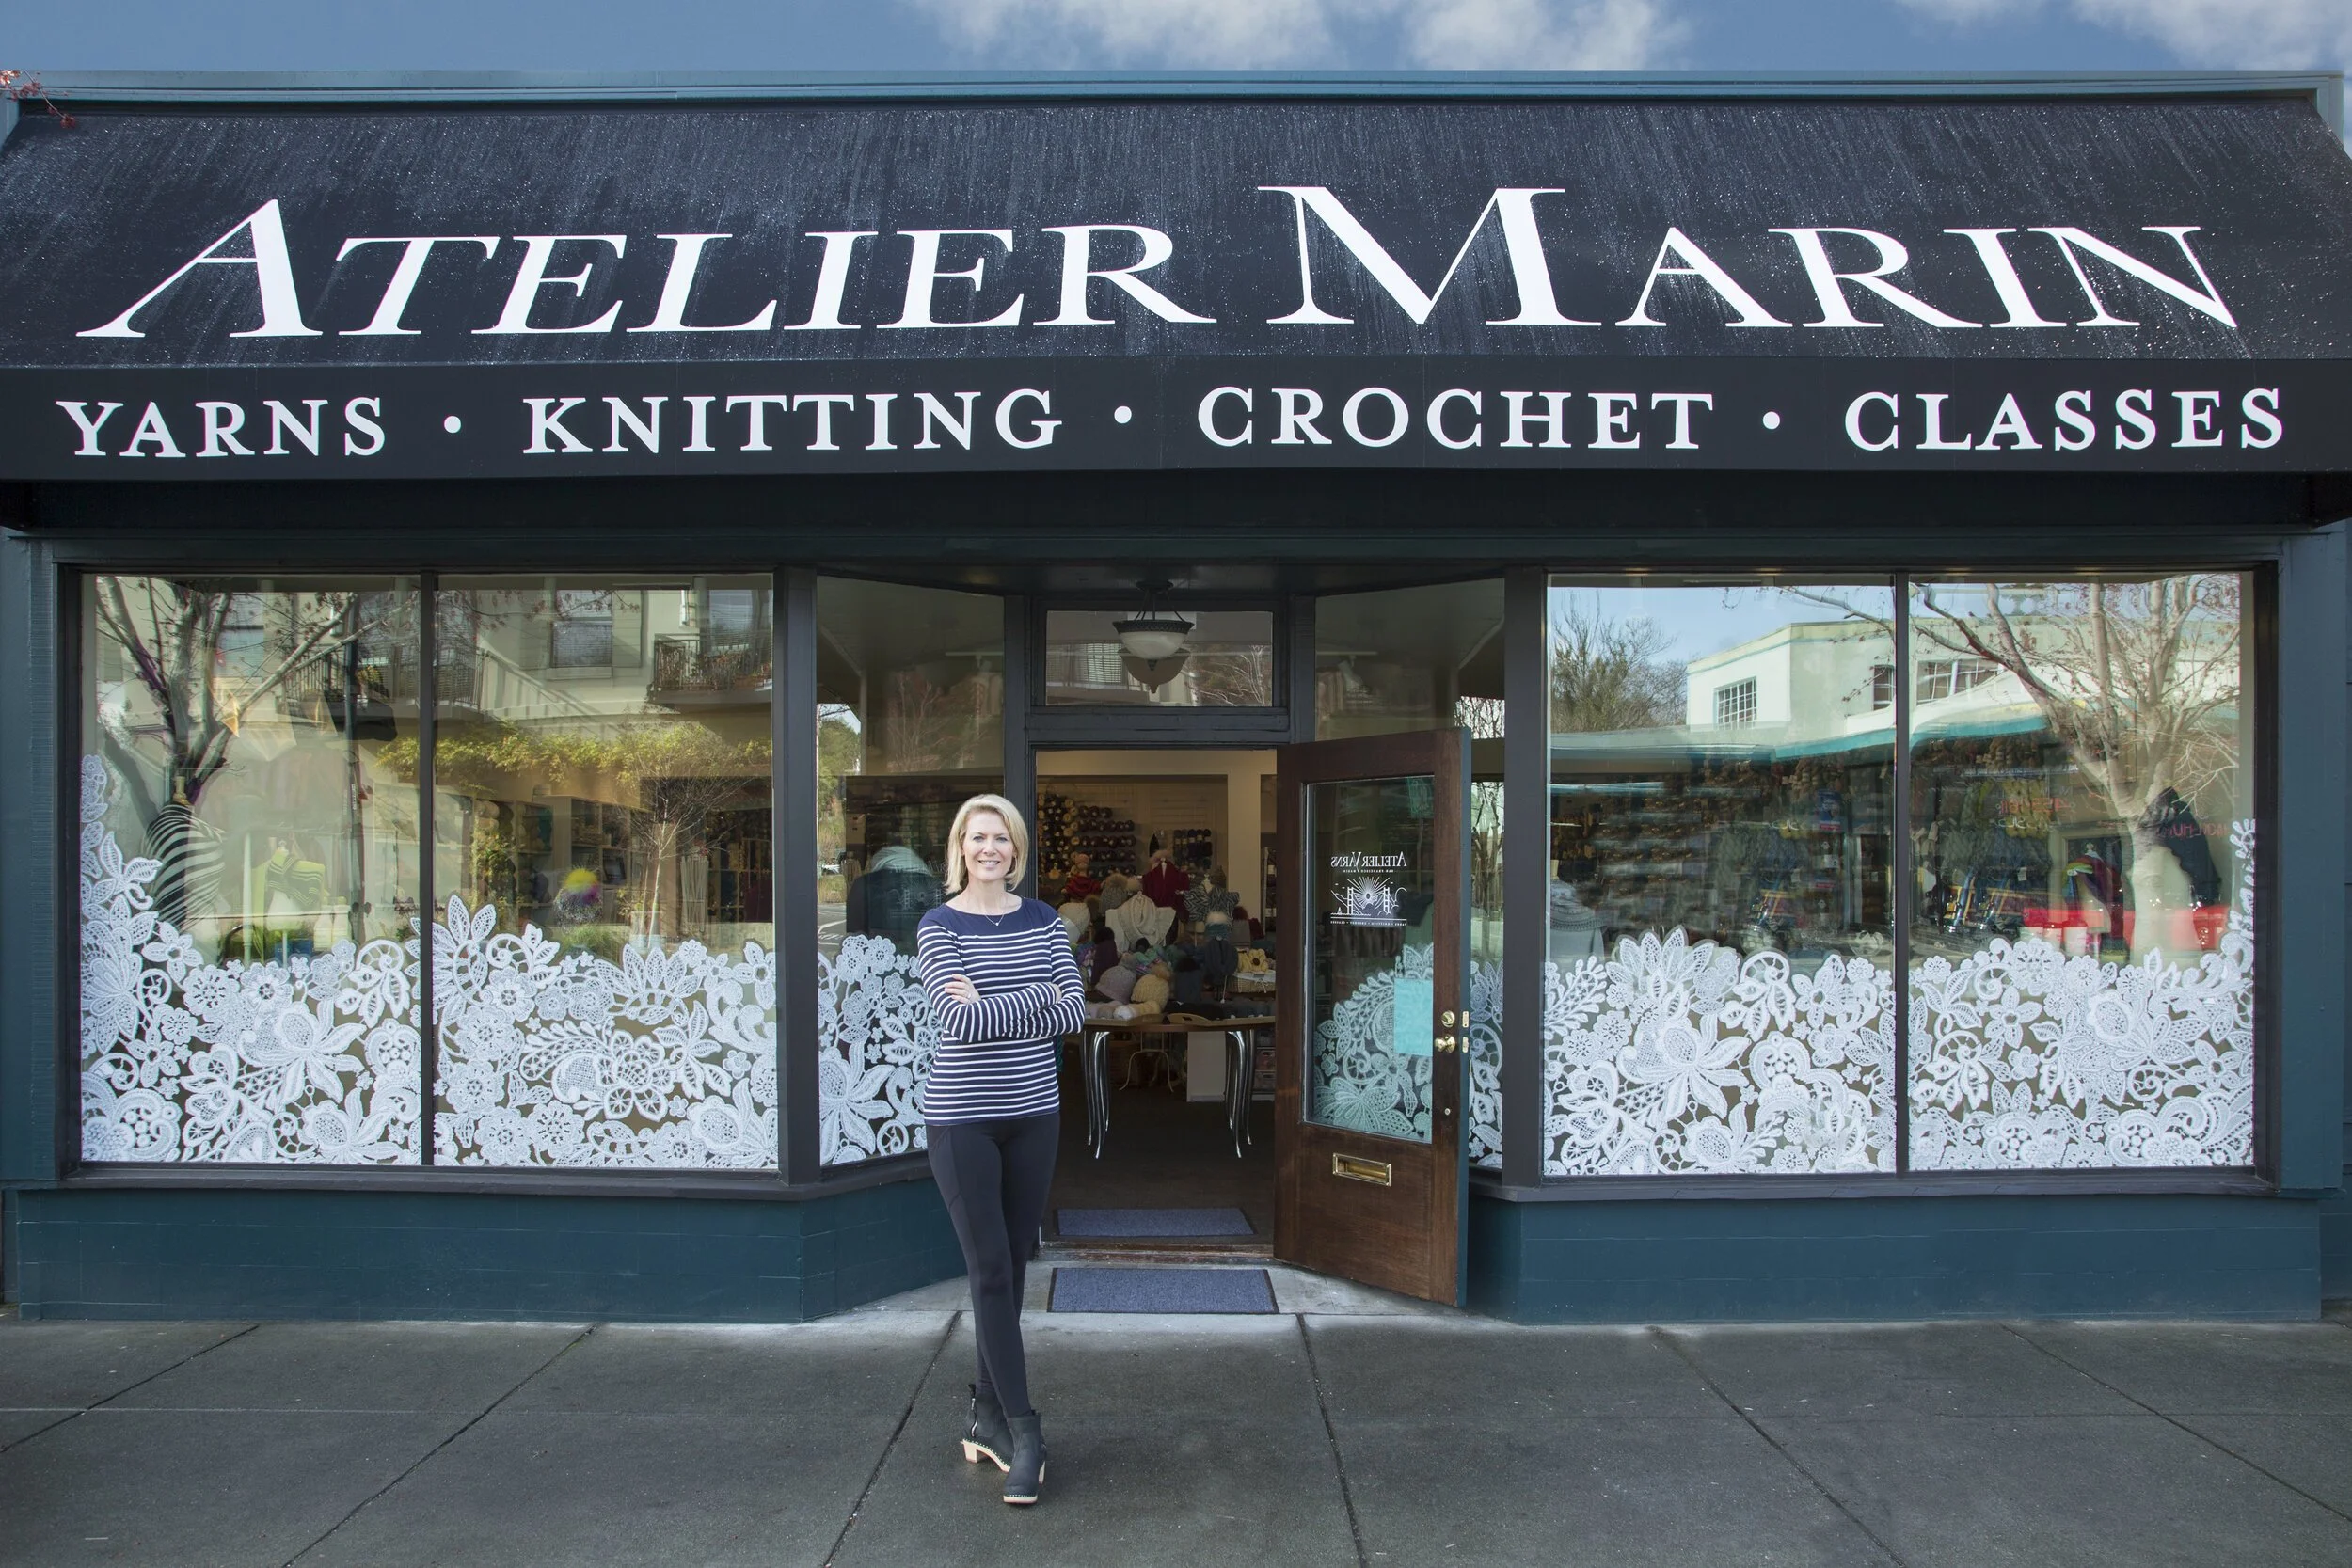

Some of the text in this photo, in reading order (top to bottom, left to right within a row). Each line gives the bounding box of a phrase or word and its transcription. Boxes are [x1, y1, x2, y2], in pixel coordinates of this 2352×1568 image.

[76, 186, 2237, 337] ATELIER MARIN
[56, 387, 2281, 457] YARNS KNITTING CROCHET CLASSES
